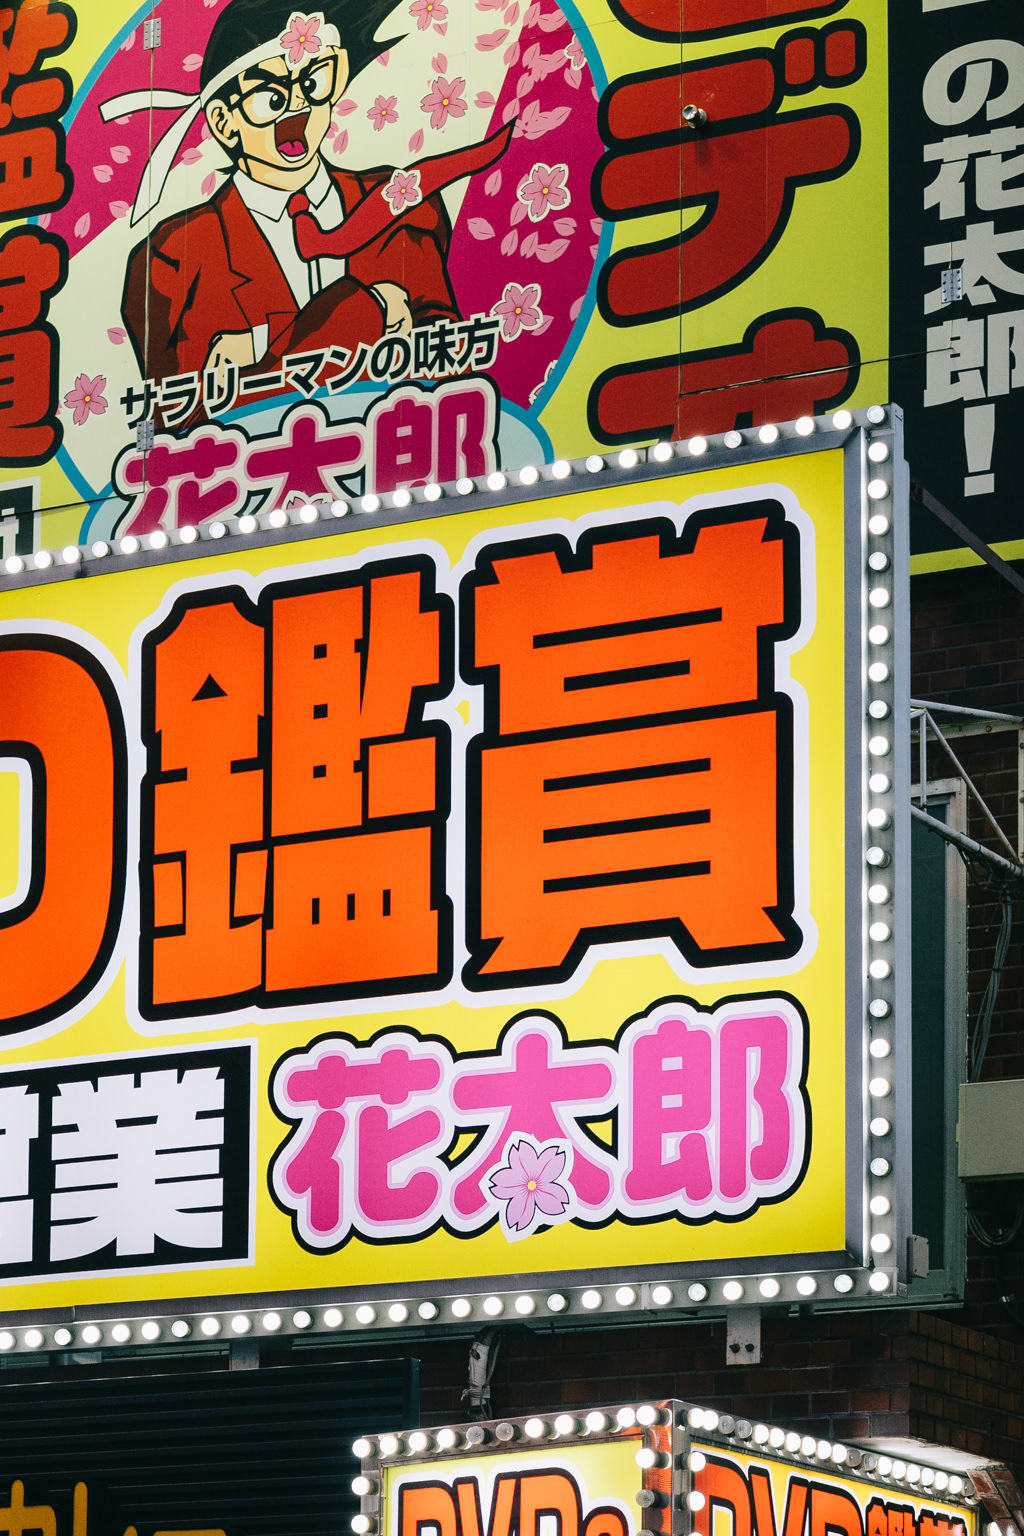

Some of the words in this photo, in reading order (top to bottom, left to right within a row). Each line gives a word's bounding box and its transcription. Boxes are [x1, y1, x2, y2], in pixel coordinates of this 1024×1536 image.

[119, 316, 501, 430] サラリーマンの味方
[921, 0, 1024, 498] の花太郎!
[274, 998, 808, 1255] 花太郎
